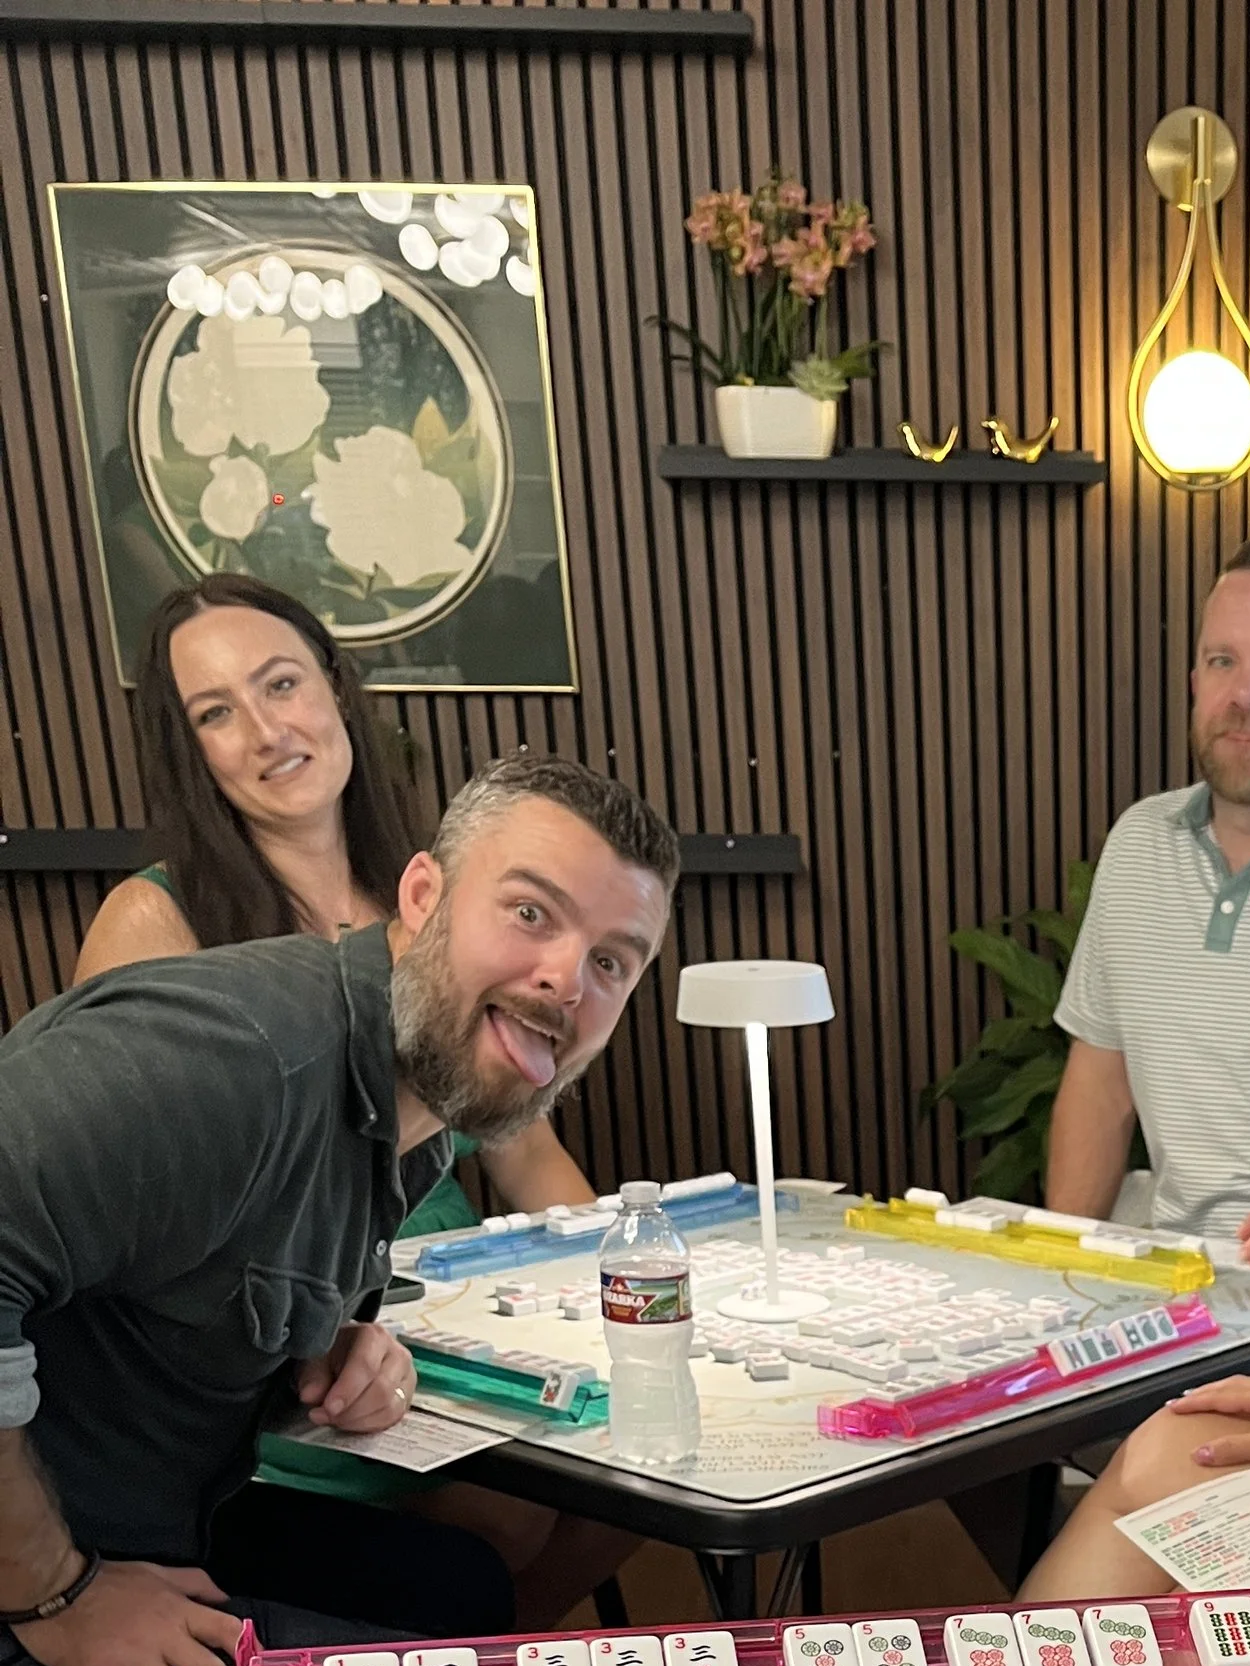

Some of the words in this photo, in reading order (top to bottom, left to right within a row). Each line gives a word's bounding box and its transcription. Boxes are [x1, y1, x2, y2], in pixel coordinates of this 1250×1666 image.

[1203, 1601, 1215, 1612] 9
[1022, 1614, 1032, 1625] 7
[1092, 1609, 1102, 1620] 7
[953, 1618, 963, 1629] 7
[795, 1628, 805, 1640] 5
[863, 1624, 873, 1635] 5
[601, 1642, 612, 1654] 3
[675, 1638, 686, 1649] 3
[528, 1647, 539, 1659] 3
[417, 1655, 423, 1666] 1
